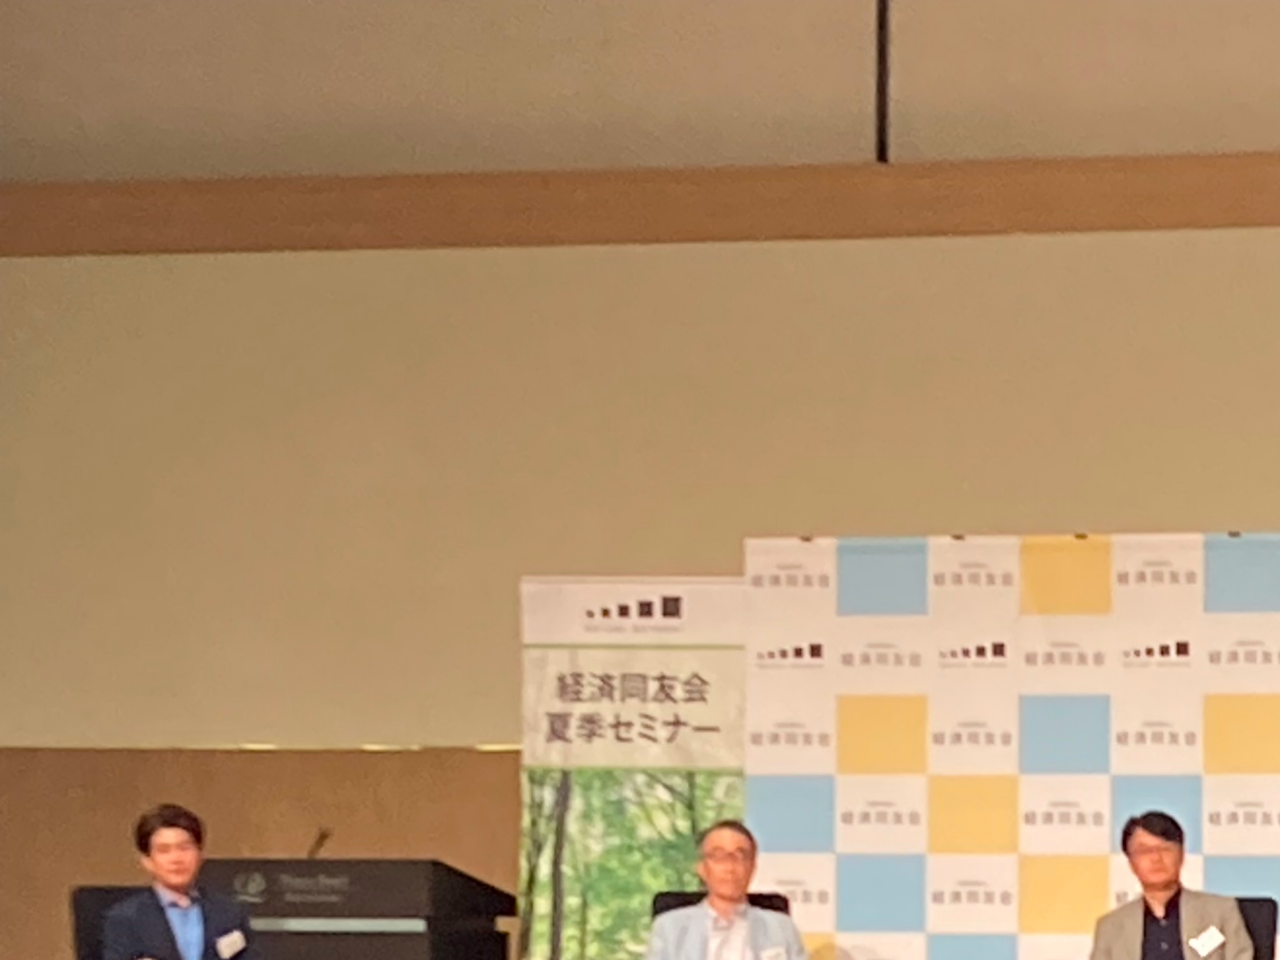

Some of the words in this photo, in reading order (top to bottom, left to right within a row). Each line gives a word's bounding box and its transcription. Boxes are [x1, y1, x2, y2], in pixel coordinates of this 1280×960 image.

[557, 671, 710, 704] 経済同友会
[545, 711, 721, 744] 夏季セミナー
